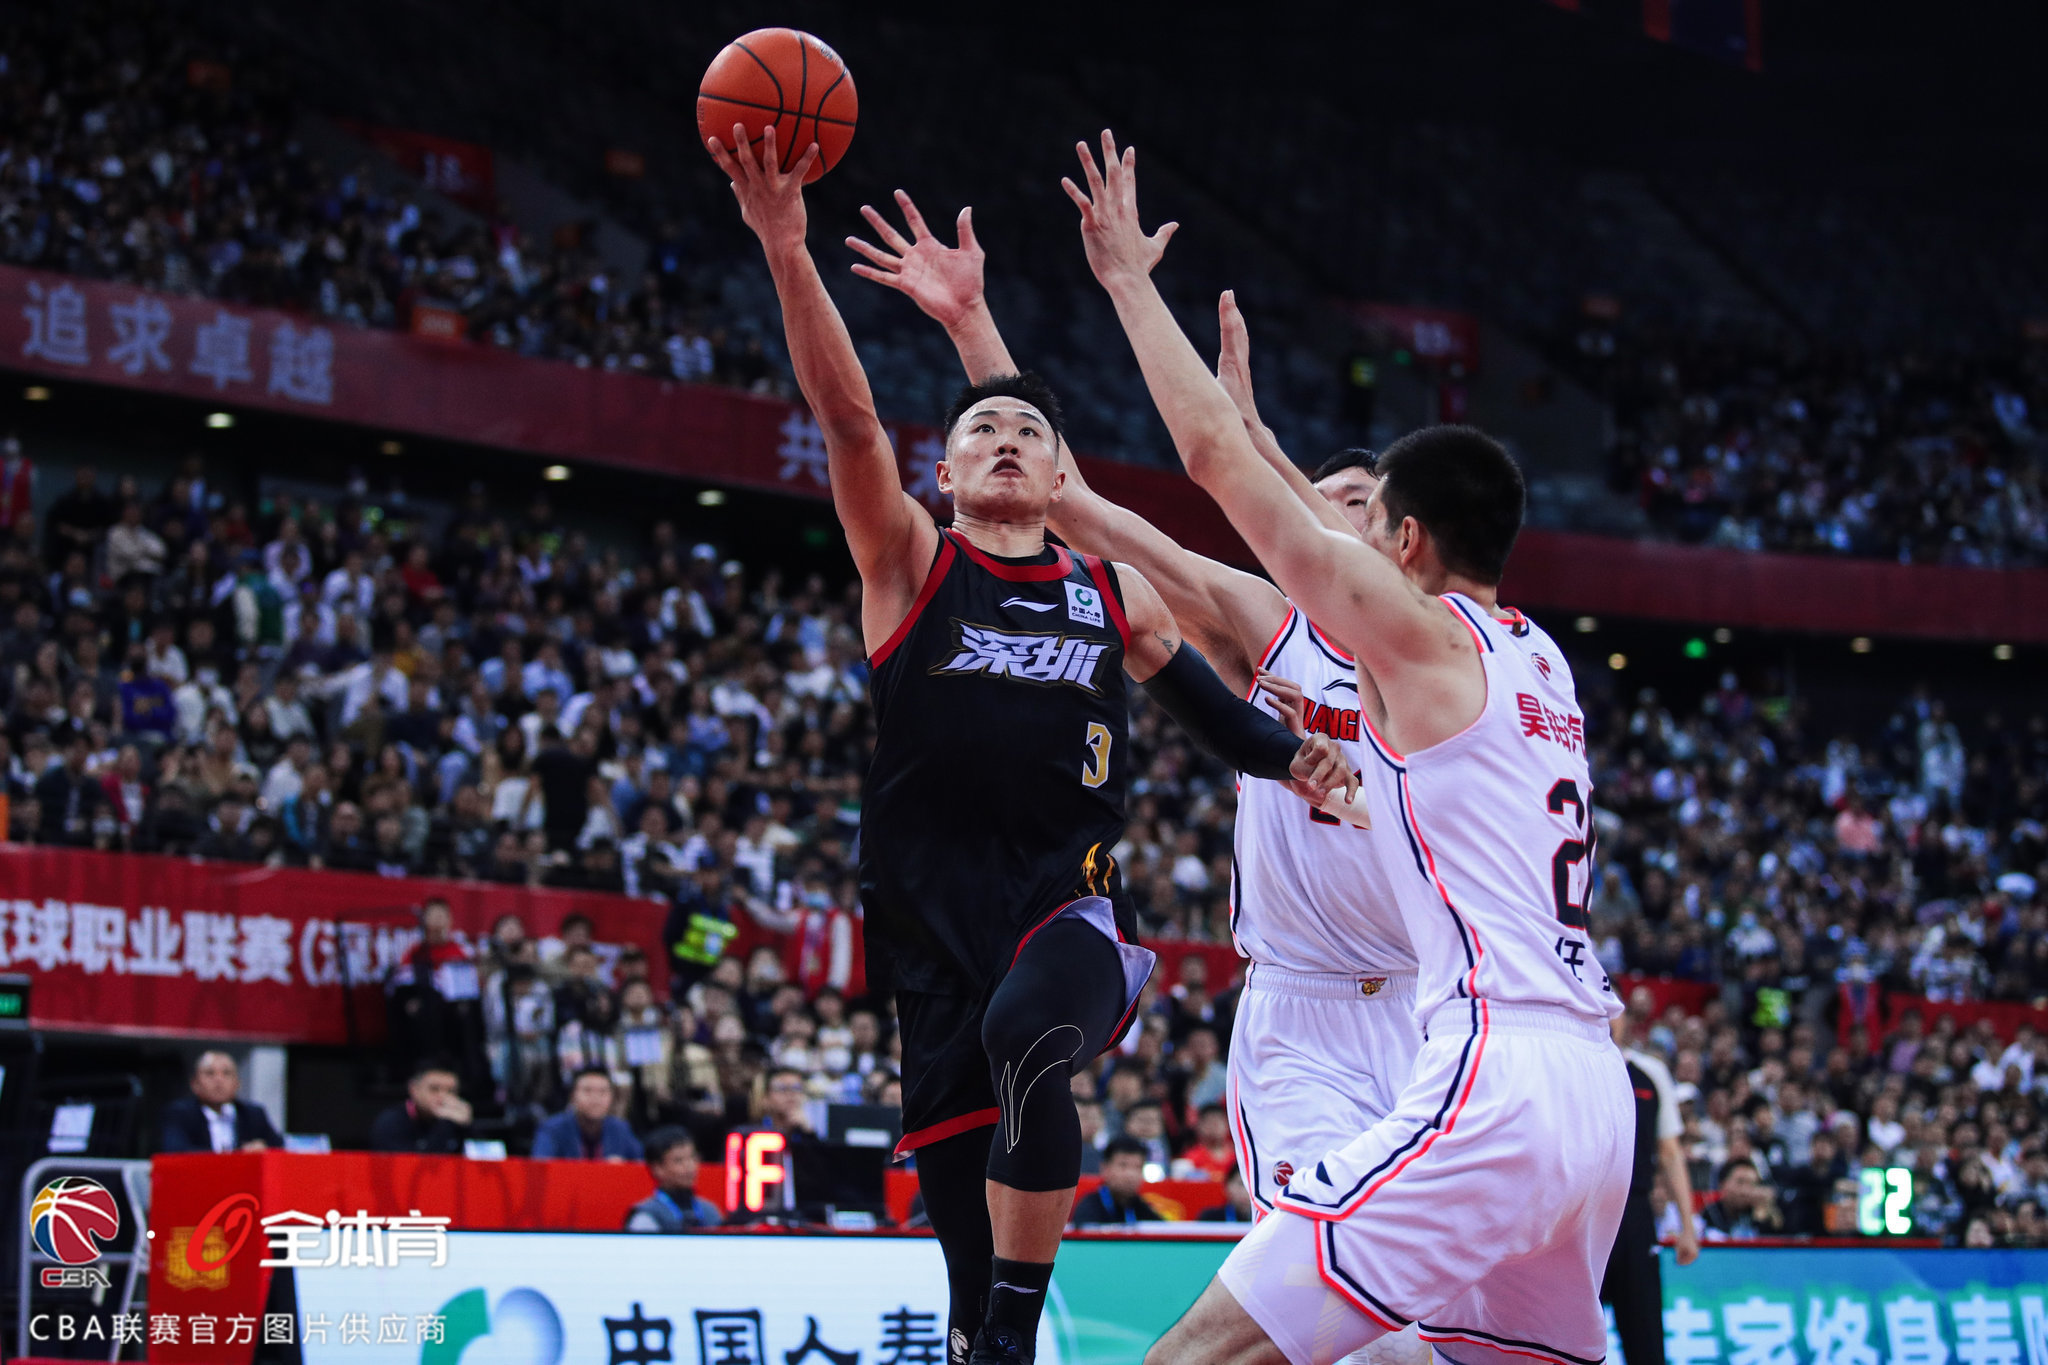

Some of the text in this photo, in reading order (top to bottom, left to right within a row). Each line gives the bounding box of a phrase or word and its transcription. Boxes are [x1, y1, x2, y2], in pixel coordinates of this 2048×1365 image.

[22, 281, 335, 404] 追求卓越
[938, 622, 1111, 692] 深圳
[1303, 696, 1361, 742] UANG
[1081, 721, 1113, 789] 3
